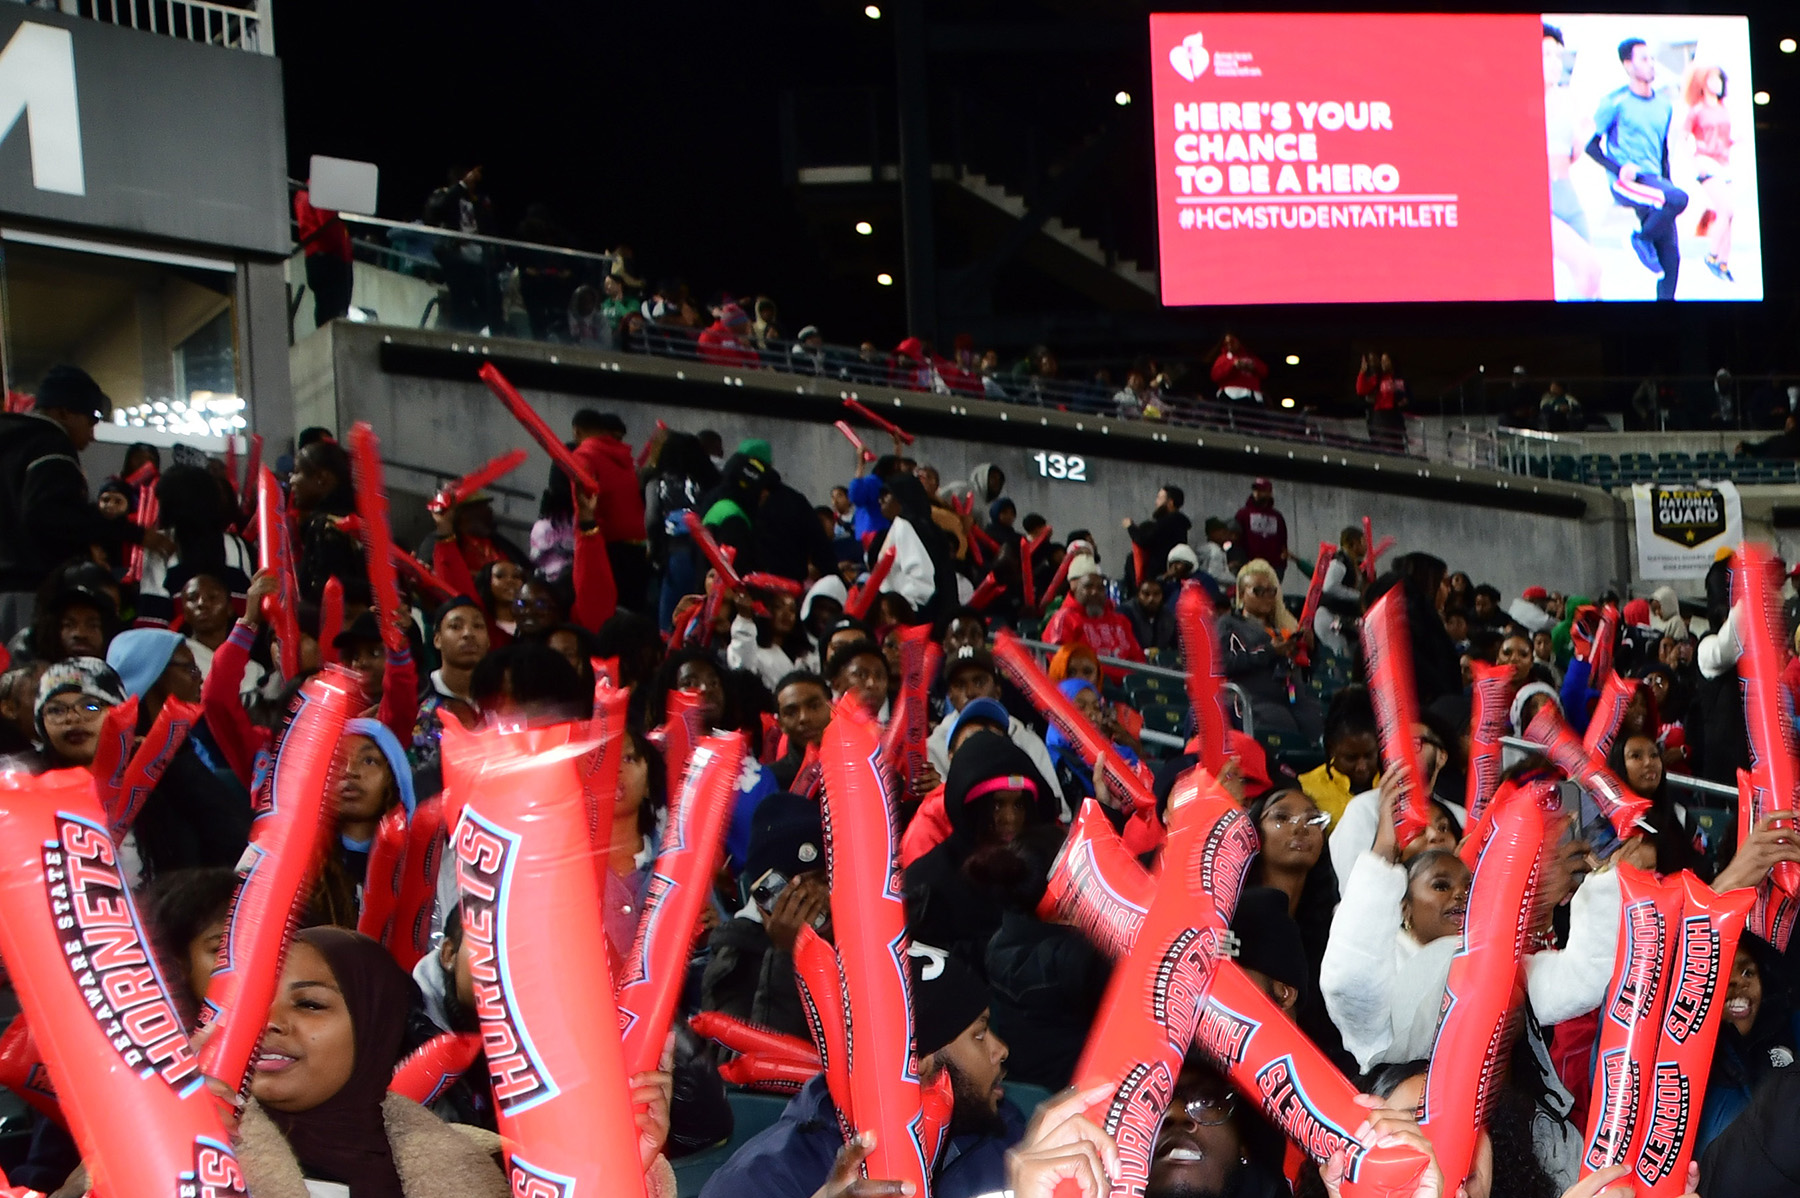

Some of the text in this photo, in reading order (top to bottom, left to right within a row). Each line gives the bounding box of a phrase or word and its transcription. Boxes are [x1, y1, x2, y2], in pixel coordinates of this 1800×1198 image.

[1175, 102, 1392, 130] HERE'S YOUR
[1175, 134, 1317, 162] CHANCE
[1177, 164, 1400, 194] TO BE A HERO
[1178, 204, 1458, 230] #HCMSTUDENTATHLETE
[1034, 453, 1086, 481] 132
[1659, 497, 1714, 508] NATIONAL
[1659, 509, 1718, 524] GUARD
[1203, 813, 1236, 888] DELAWARE STATE
[1213, 815, 1257, 917] HORNETS
[46, 852, 142, 1068] DELAWARE STATE
[61, 822, 199, 1083] HORNETS
[457, 819, 540, 1101] HORNETS
[1515, 890, 1530, 958] DELAWARE
[1614, 907, 1659, 1024] HORNETS
[1644, 920, 1665, 1015] DELAWARE STATE
[1156, 929, 1194, 1017] DELAWARE STATE
[1167, 931, 1219, 1048] HORNETS
[1667, 922, 1711, 1039] HORNETS
[1692, 936, 1720, 1030] DELAWARE STATE
[1107, 1066, 1147, 1135] WARE STATE
[1475, 1059, 1490, 1125] DELAWARE
[1619, 1067, 1639, 1162] DELAWARE STATE
[1639, 1068, 1681, 1181] HORNETS
[1664, 1081, 1688, 1173] DELAWARE STATE
